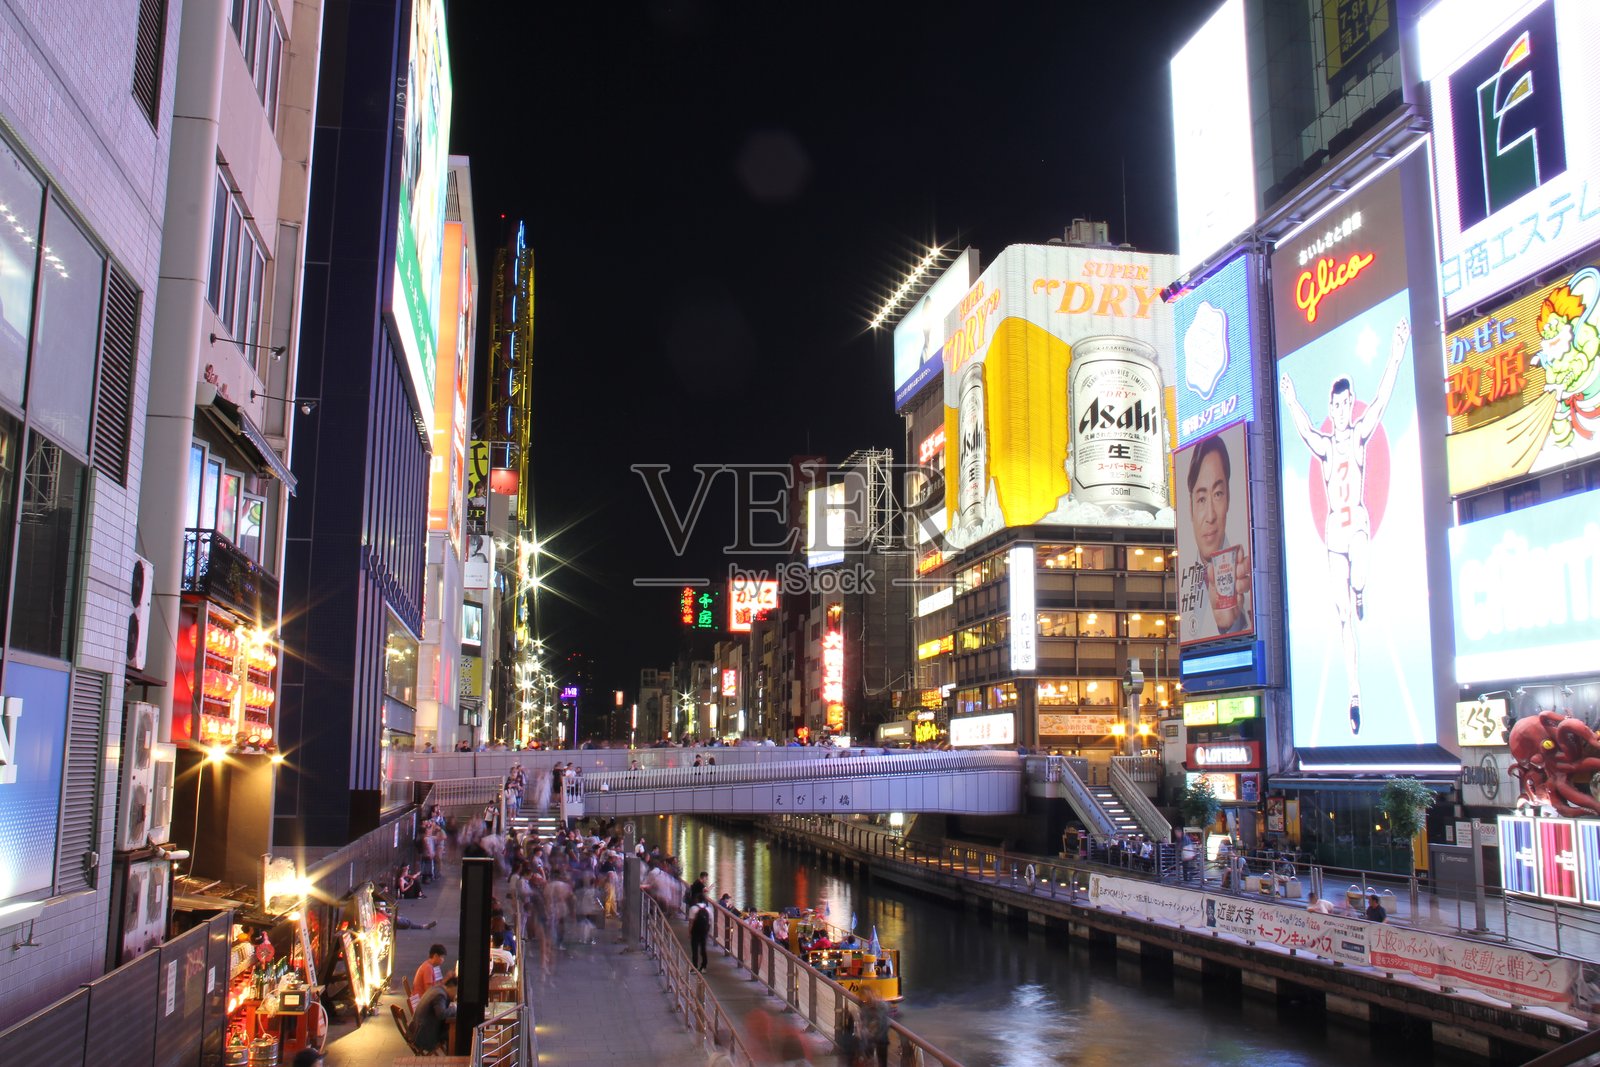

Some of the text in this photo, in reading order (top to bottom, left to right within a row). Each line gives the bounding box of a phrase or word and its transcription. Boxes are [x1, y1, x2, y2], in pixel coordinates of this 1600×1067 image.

[1081, 259, 1149, 280] SUPER
[960, 280, 984, 321] SUPER
[1296, 253, 1374, 322] Glico
[1449, 317, 1517, 364] かぜに
[1445, 342, 1528, 416] 改源
[1079, 396, 1157, 436] Asahi
[1108, 443, 1131, 460] 生
[1097, 463, 1143, 472] スーパードライ
[1110, 487, 1132, 496] 350ml
[736, 588, 774, 605] かに
[1466, 707, 1496, 739] くくる
[1205, 748, 1248, 764] LOTTERIA
[775, 794, 850, 806] えびす橋
[1217, 903, 1254, 925] 近畿大学
[1257, 924, 1333, 954] オープンキャンパス
[1375, 928, 1558, 989] 大阪のみらいに、感動を贈ろう。
